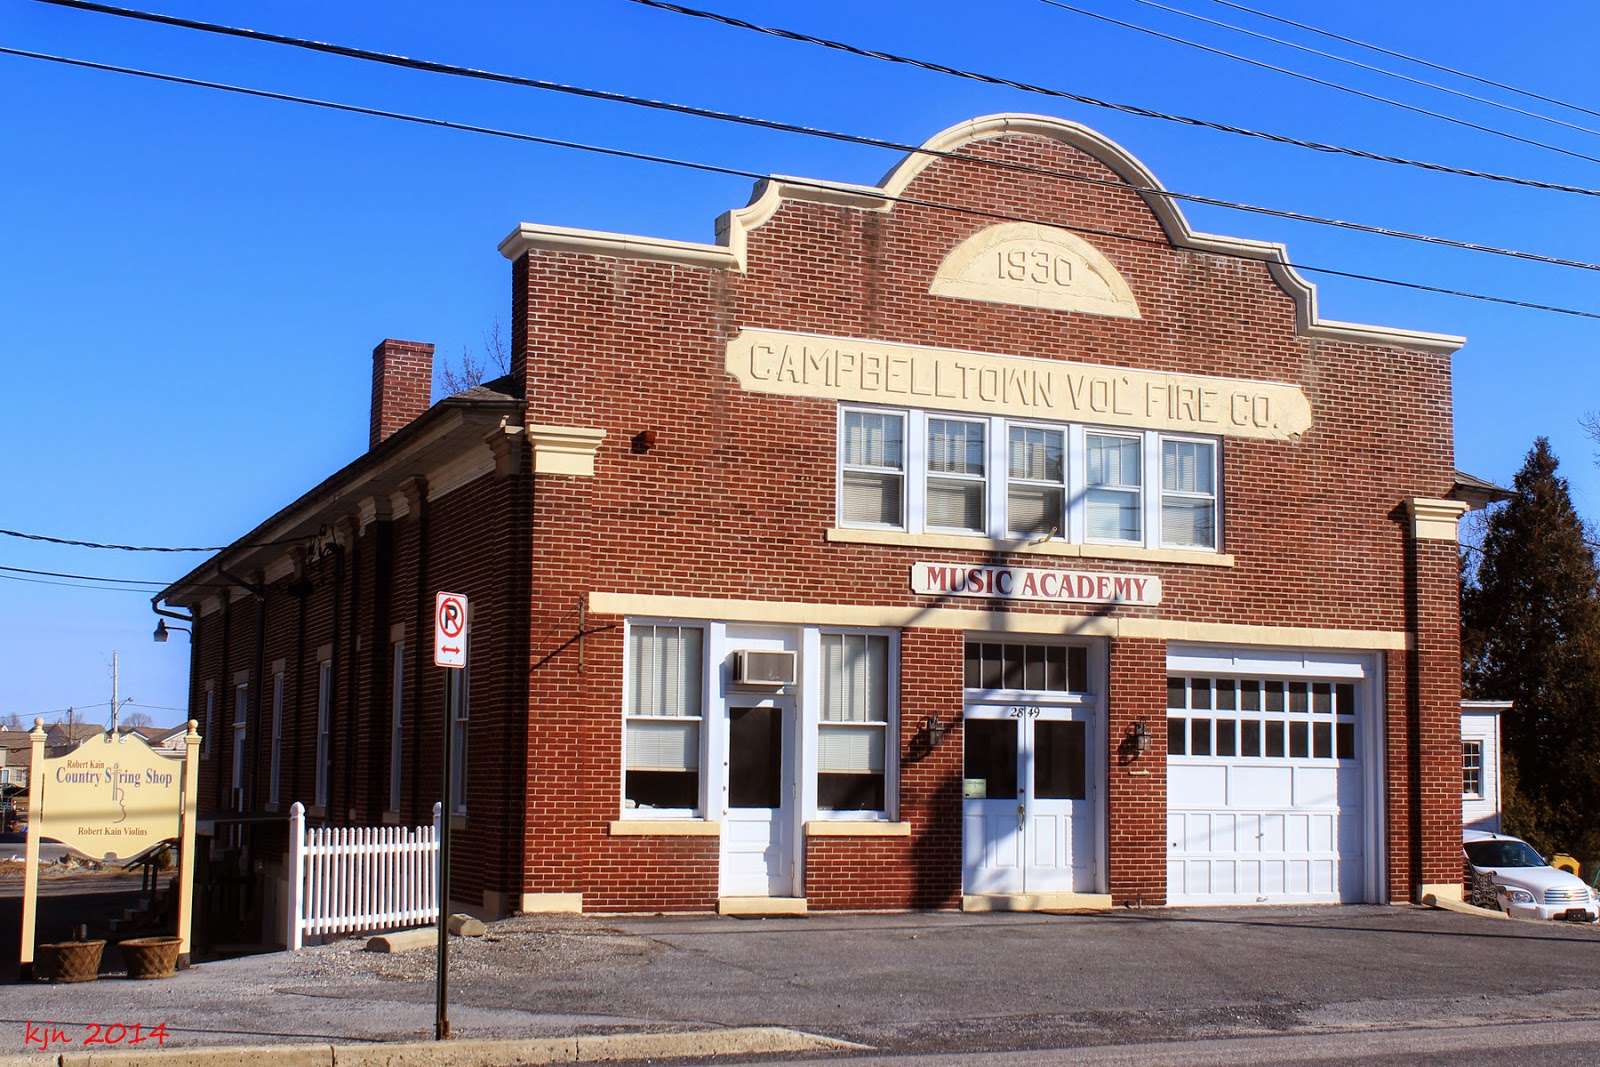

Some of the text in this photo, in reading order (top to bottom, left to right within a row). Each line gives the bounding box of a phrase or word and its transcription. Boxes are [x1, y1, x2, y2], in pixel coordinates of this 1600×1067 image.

[997, 249, 1073, 288] 1930
[749, 340, 1054, 408] CAMPBELLTOWN
[1145, 380, 1219, 424] FIRE
[1230, 390, 1280, 430] CO.
[926, 566, 1149, 602] MUSIC ACADEMY
[56, 766, 101, 788] Country
[146, 767, 172, 788] Shop
[67, 759, 105, 769] Robert Kain
[78, 826, 148, 836] Robert Kain Violins
